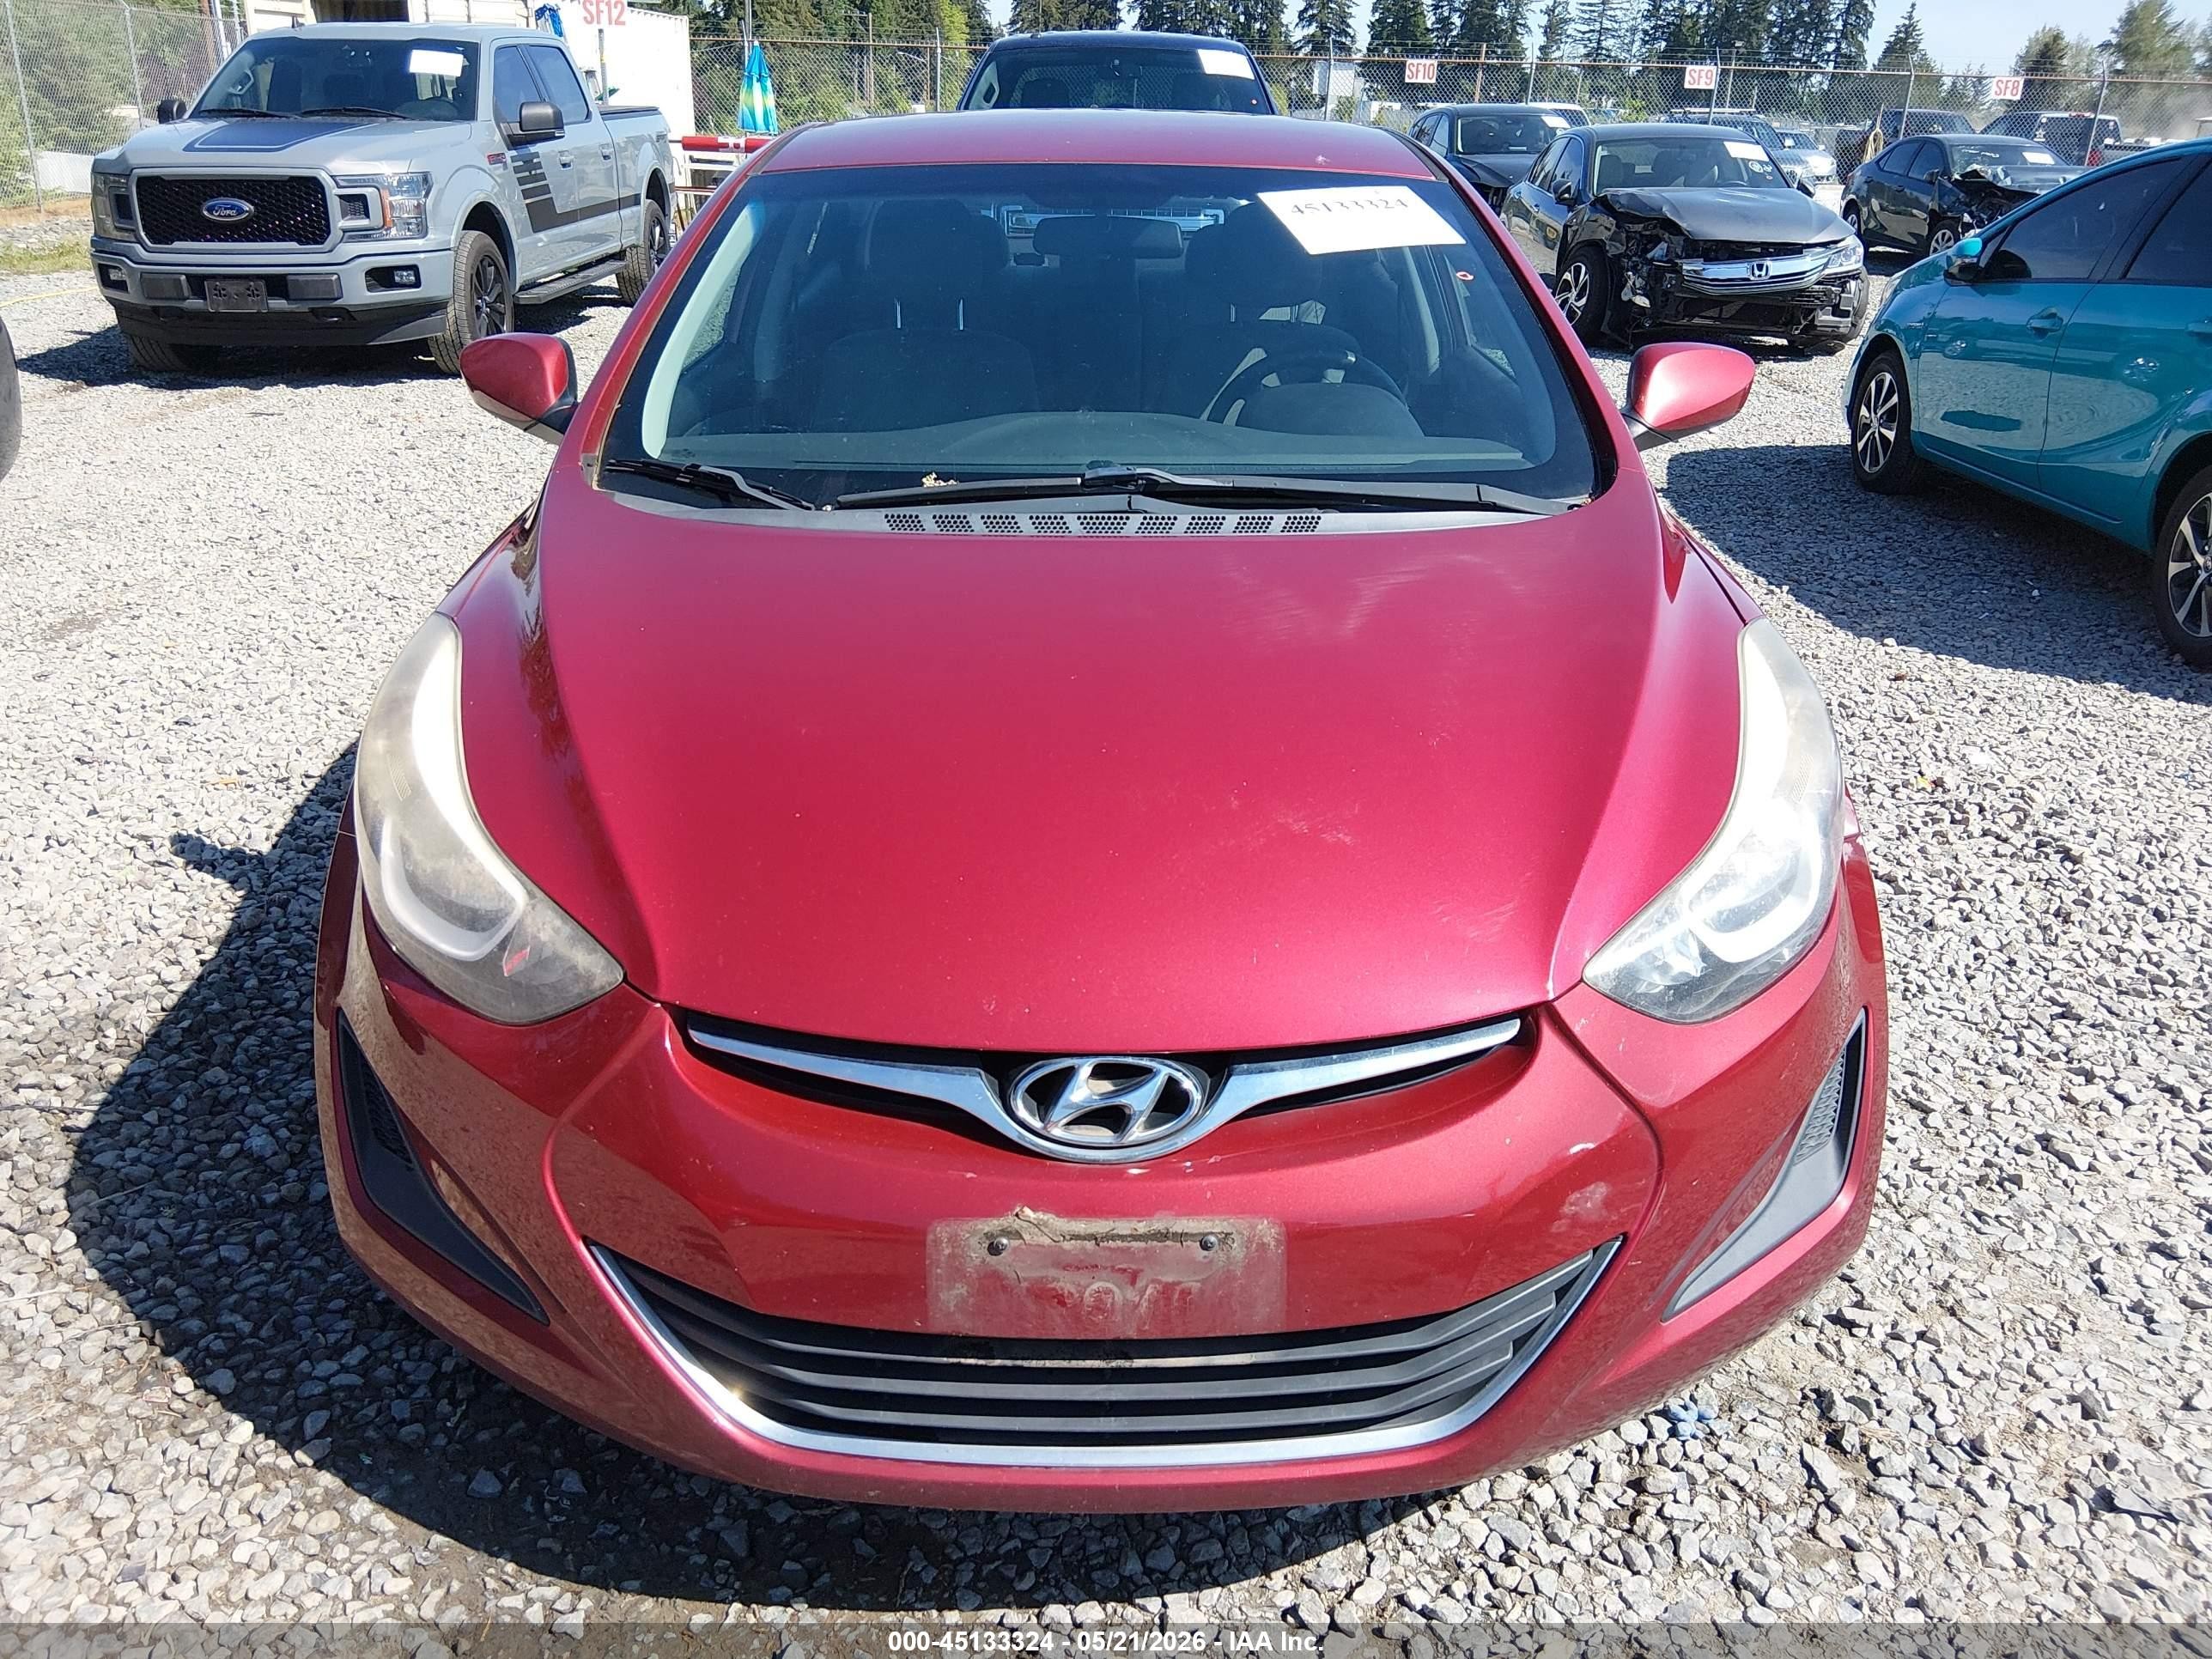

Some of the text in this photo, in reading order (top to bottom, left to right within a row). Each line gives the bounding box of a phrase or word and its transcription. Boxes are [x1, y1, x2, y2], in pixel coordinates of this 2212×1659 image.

[582, 0, 626, 26] SF12
[1407, 63, 1435, 81] SF10
[1687, 68, 1713, 86] SF9
[1995, 80, 2020, 97] SF8
[212, 205, 239, 217] Ford
